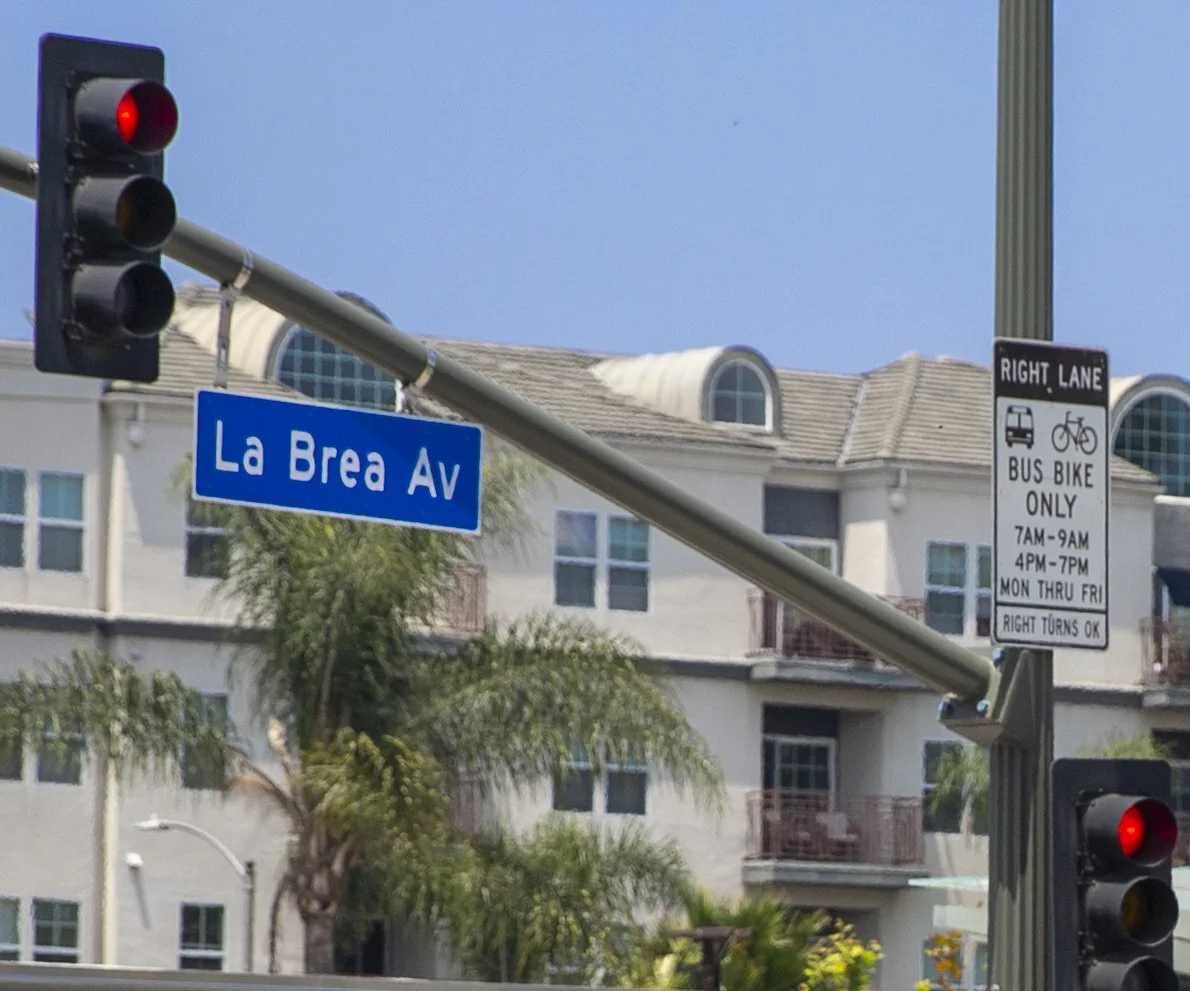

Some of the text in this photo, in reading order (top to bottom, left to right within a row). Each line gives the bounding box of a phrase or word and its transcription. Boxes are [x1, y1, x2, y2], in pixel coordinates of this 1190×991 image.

[1001, 358, 1103, 391] RIGHT LANE
[215, 419, 460, 501] La Brea Av
[1008, 456, 1094, 488] BUS BIKE
[1026, 490, 1077, 518] ONLY
[1000, 577, 1102, 604] MON THRU FRI
[1003, 614, 1100, 639] RIGHT TURNS OK
